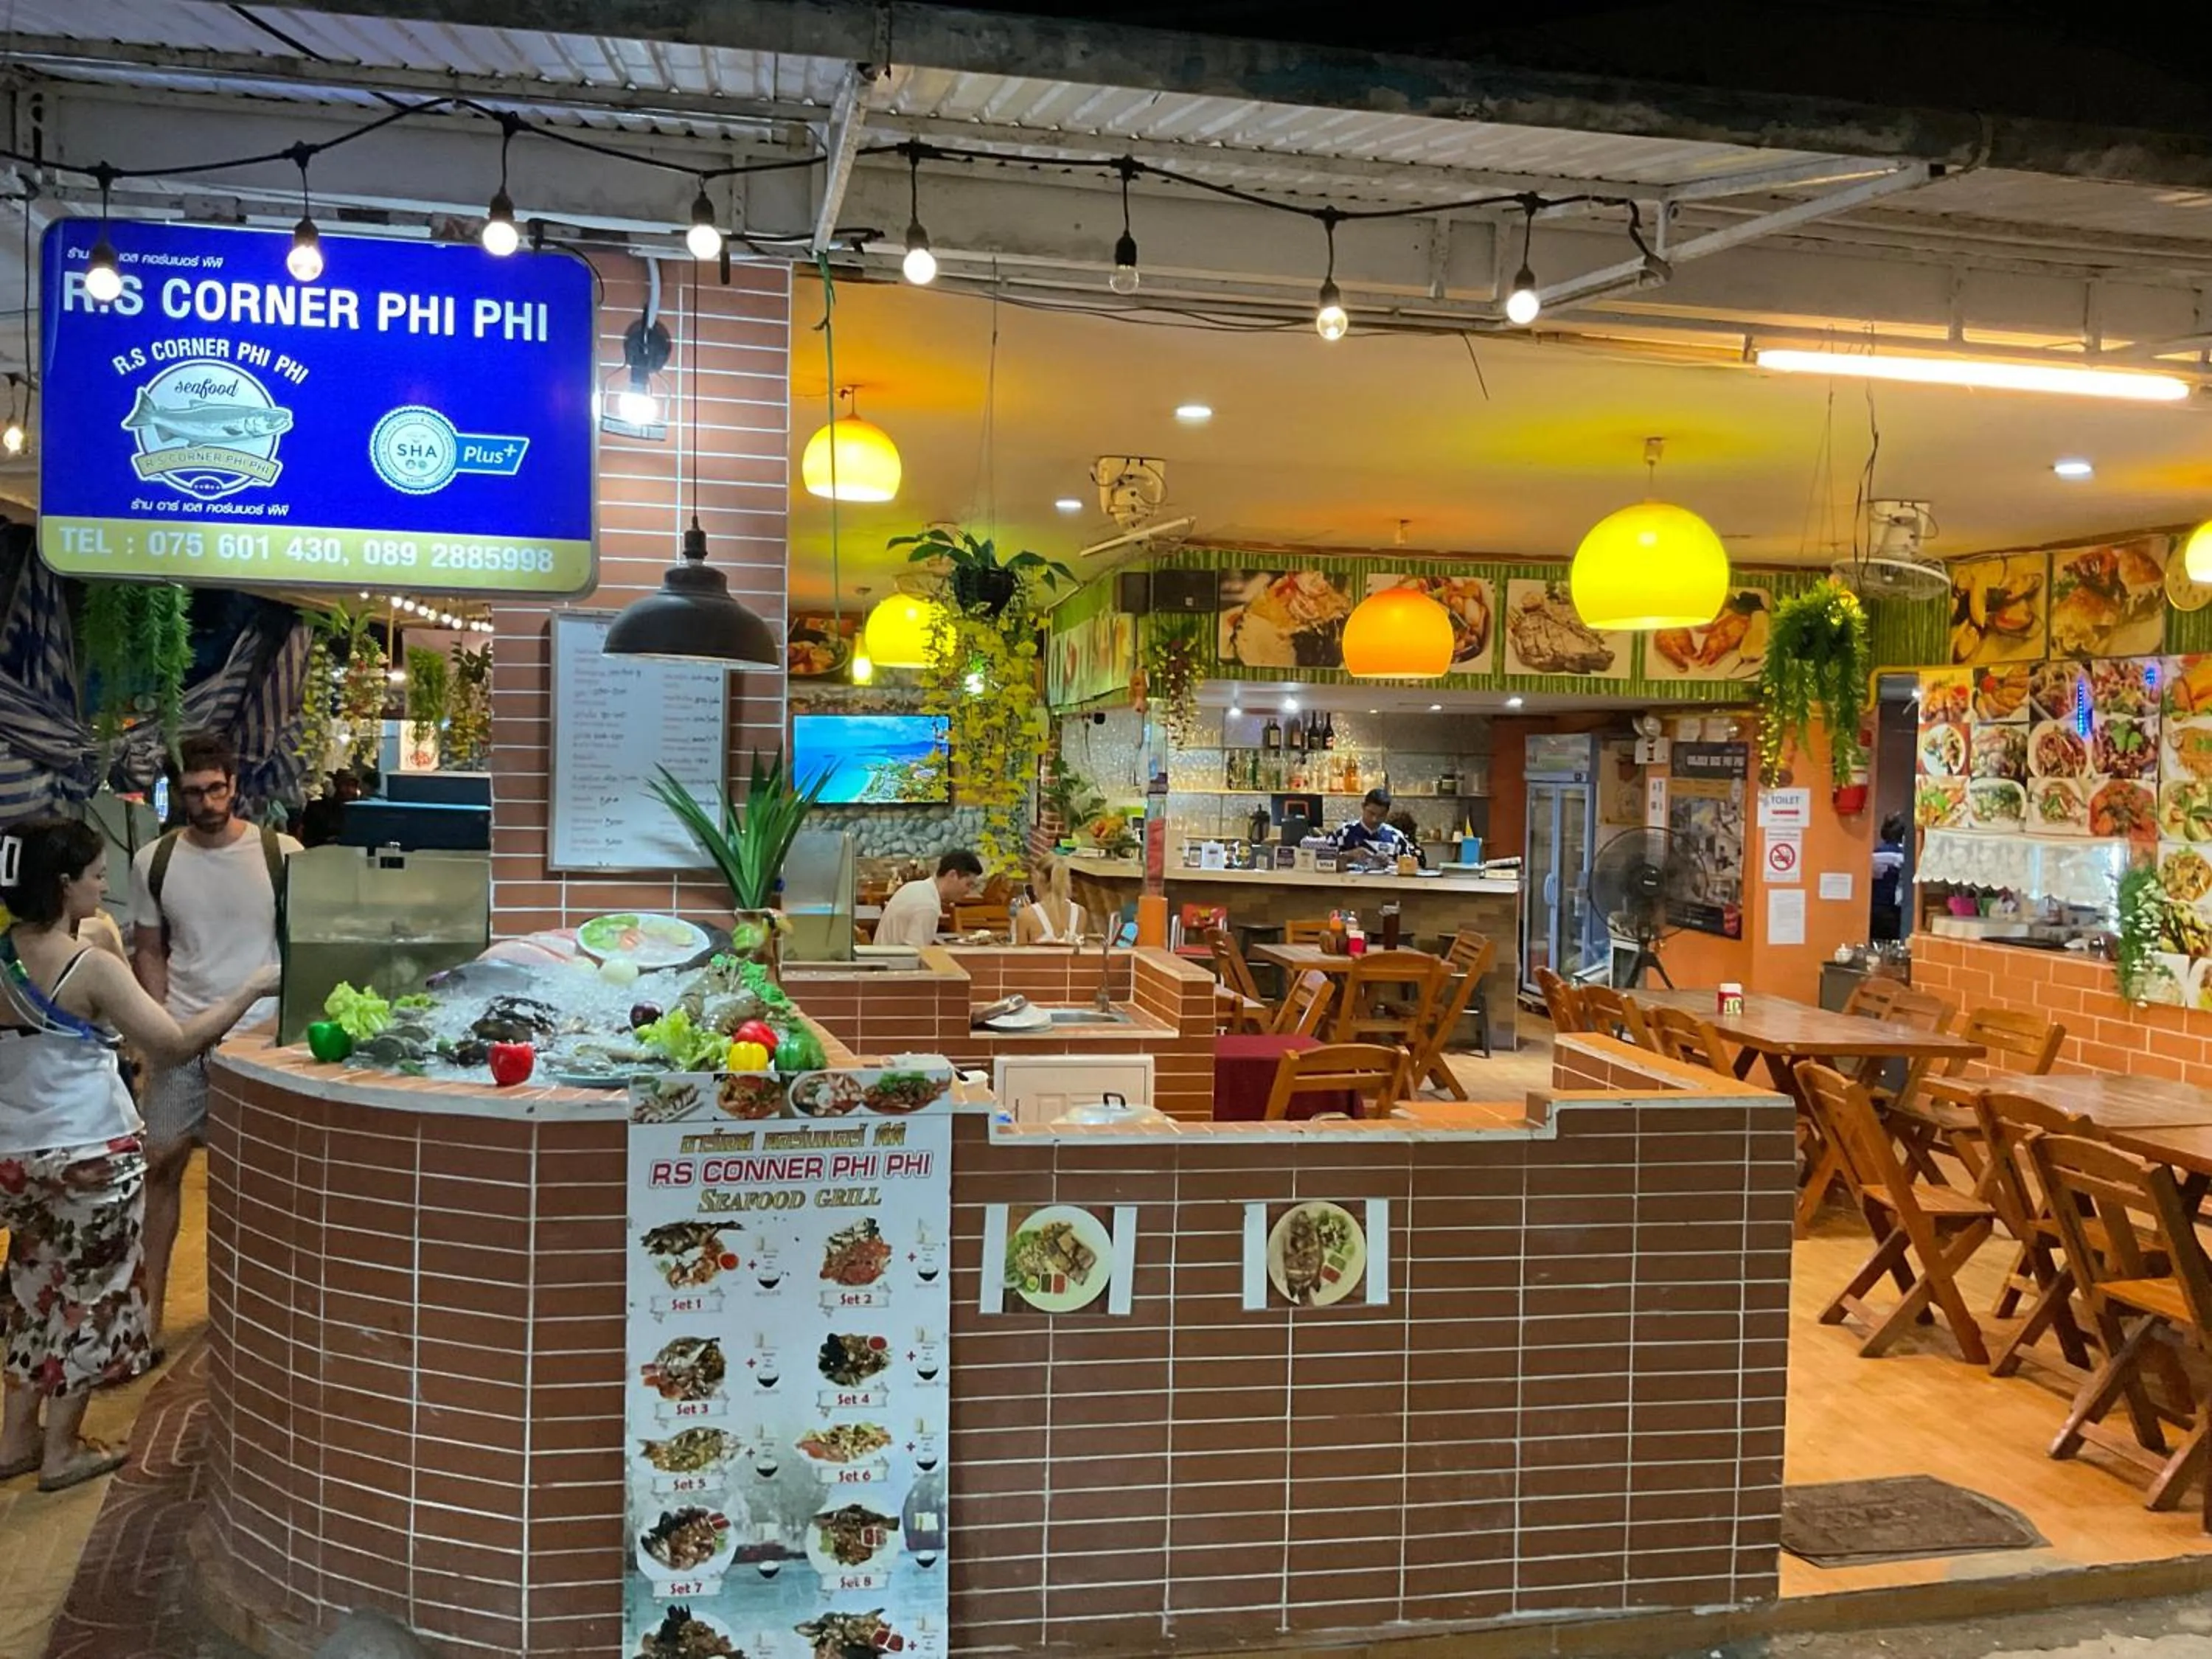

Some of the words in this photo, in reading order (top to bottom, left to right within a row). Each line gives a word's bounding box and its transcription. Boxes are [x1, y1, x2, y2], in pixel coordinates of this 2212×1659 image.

[63, 271, 144, 316] R.S
[162, 278, 358, 329] CORNER
[378, 293, 455, 335] PHI
[474, 299, 549, 341] PHI
[112, 348, 147, 375] R.S
[151, 338, 229, 361] CORNER
[237, 341, 271, 366] PHI
[274, 355, 309, 384] PHI
[174, 378, 239, 399] seafood
[397, 444, 437, 458] SHA
[169, 451, 221, 462] CORNER
[226, 456, 247, 469] PHI
[249, 462, 269, 473] PHI
[131, 498, 153, 510] ร้าน
[59, 527, 112, 554] TEL
[148, 530, 204, 557] 075
[218, 533, 269, 559] 601
[286, 537, 349, 567] 430,
[364, 539, 417, 566] 089
[431, 543, 553, 573] 2885998
[1770, 796, 1800, 804] TOILET
[650, 1158, 694, 1186] RS
[702, 1156, 824, 1183] CONNER
[832, 1154, 877, 1178] PHI
[886, 1152, 931, 1177] PHI
[698, 1189, 807, 1212] SEAFOOD
[814, 1187, 882, 1207] GRILL
[672, 1299, 693, 1310] Set
[840, 1294, 860, 1305] Set
[863, 1294, 872, 1304] 2
[838, 1394, 859, 1405] Set
[861, 1394, 870, 1404] 4
[676, 1404, 697, 1416] Set
[700, 1405, 709, 1414] 3
[838, 1470, 860, 1482] Set
[863, 1470, 872, 1481] 6
[673, 1479, 695, 1492] Set
[698, 1479, 706, 1489] 5
[670, 1582, 692, 1595] Set
[695, 1582, 703, 1593] 7
[840, 1576, 861, 1588] Set
[863, 1576, 872, 1586] 8
